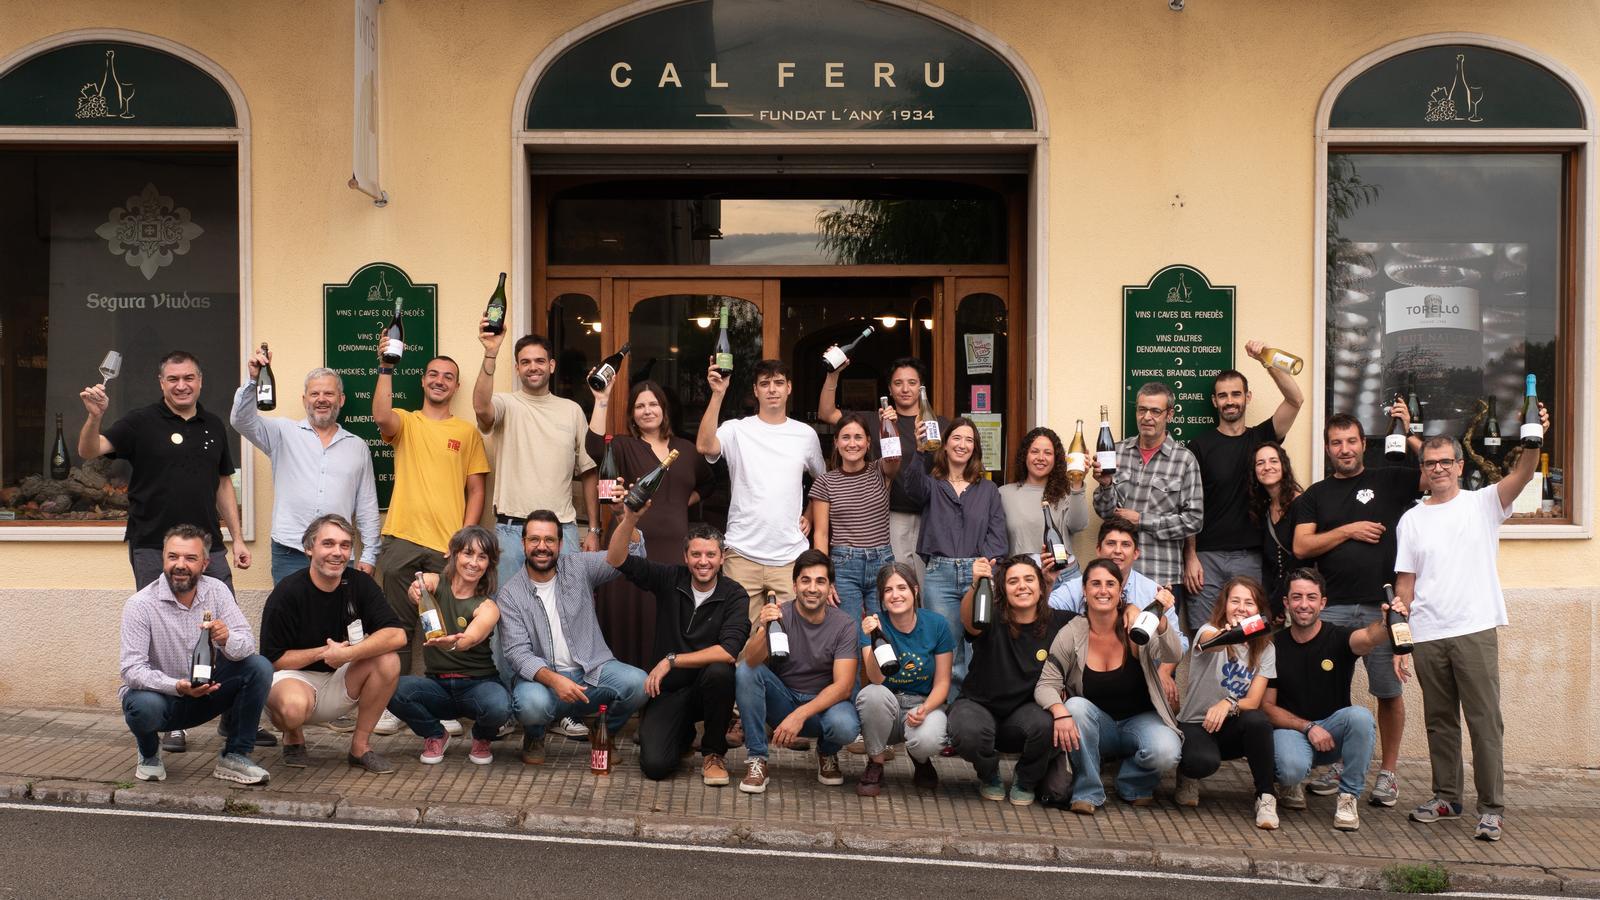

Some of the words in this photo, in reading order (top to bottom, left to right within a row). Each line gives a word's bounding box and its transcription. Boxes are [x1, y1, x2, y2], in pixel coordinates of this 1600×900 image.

[610, 62, 729, 88] CAL
[778, 62, 945, 88] FERU
[760, 110, 827, 121] FUNDAT
[891, 110, 935, 121] 1934
[86, 293, 146, 312] Segura
[150, 289, 211, 309] Viudas
[1135, 311, 1151, 319] VINS
[1157, 311, 1179, 319] CAVES
[1181, 311, 1192, 319] DEL
[338, 344, 378, 352] DENOMINACI
[1187, 416, 1215, 424] SELECTA
